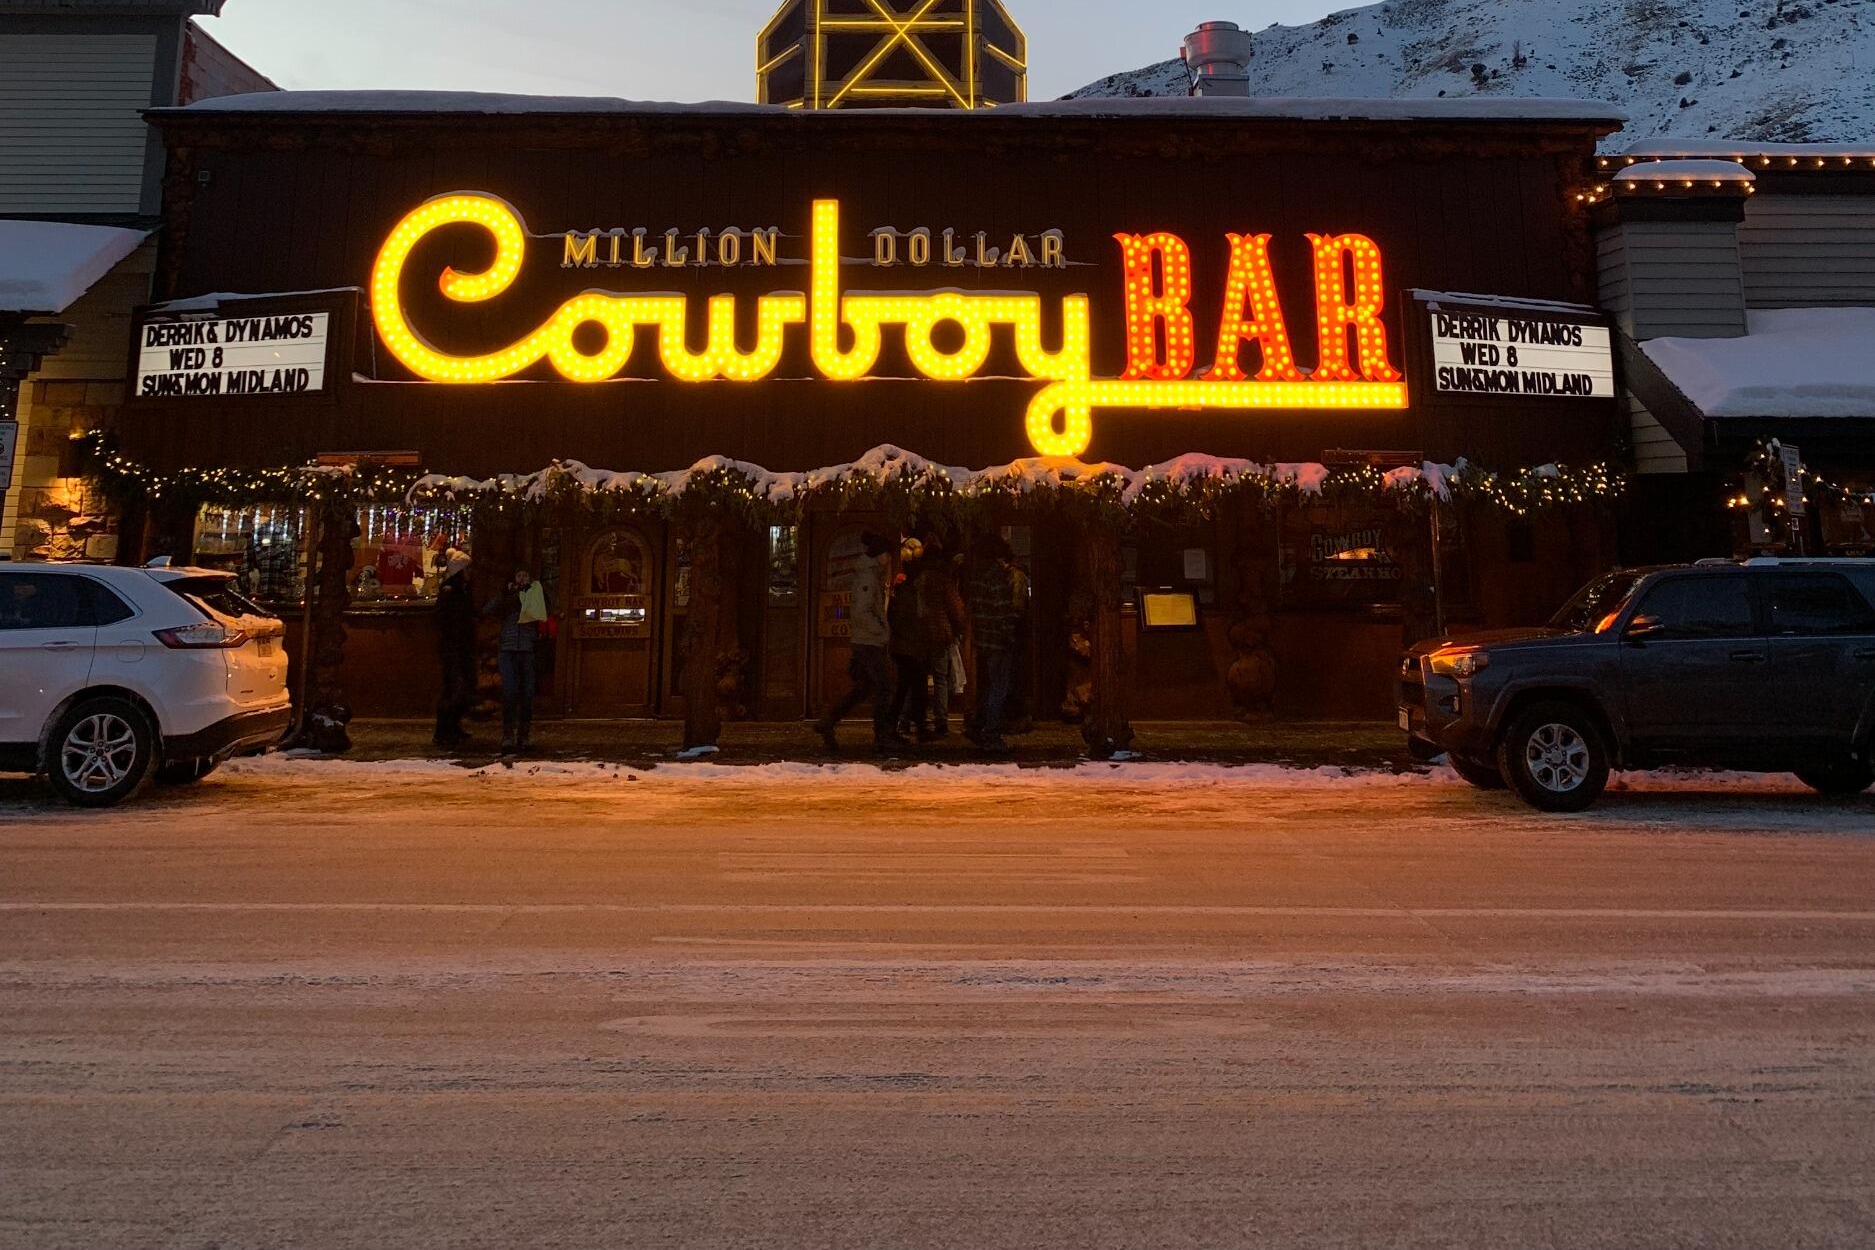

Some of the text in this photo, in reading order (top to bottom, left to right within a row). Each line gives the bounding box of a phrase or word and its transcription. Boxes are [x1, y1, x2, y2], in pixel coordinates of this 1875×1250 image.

[561, 231, 1067, 268] MILLION DOLLAR
[225, 314, 314, 343] DYNAMOS
[371, 194, 1402, 458] Cowboy BAR
[1437, 313, 1501, 342] DERRIK
[169, 345, 224, 371] WED 8
[1460, 342, 1518, 368] WED 8
[226, 367, 310, 394] MIDLAND
[1522, 370, 1593, 396] MIDLAND
